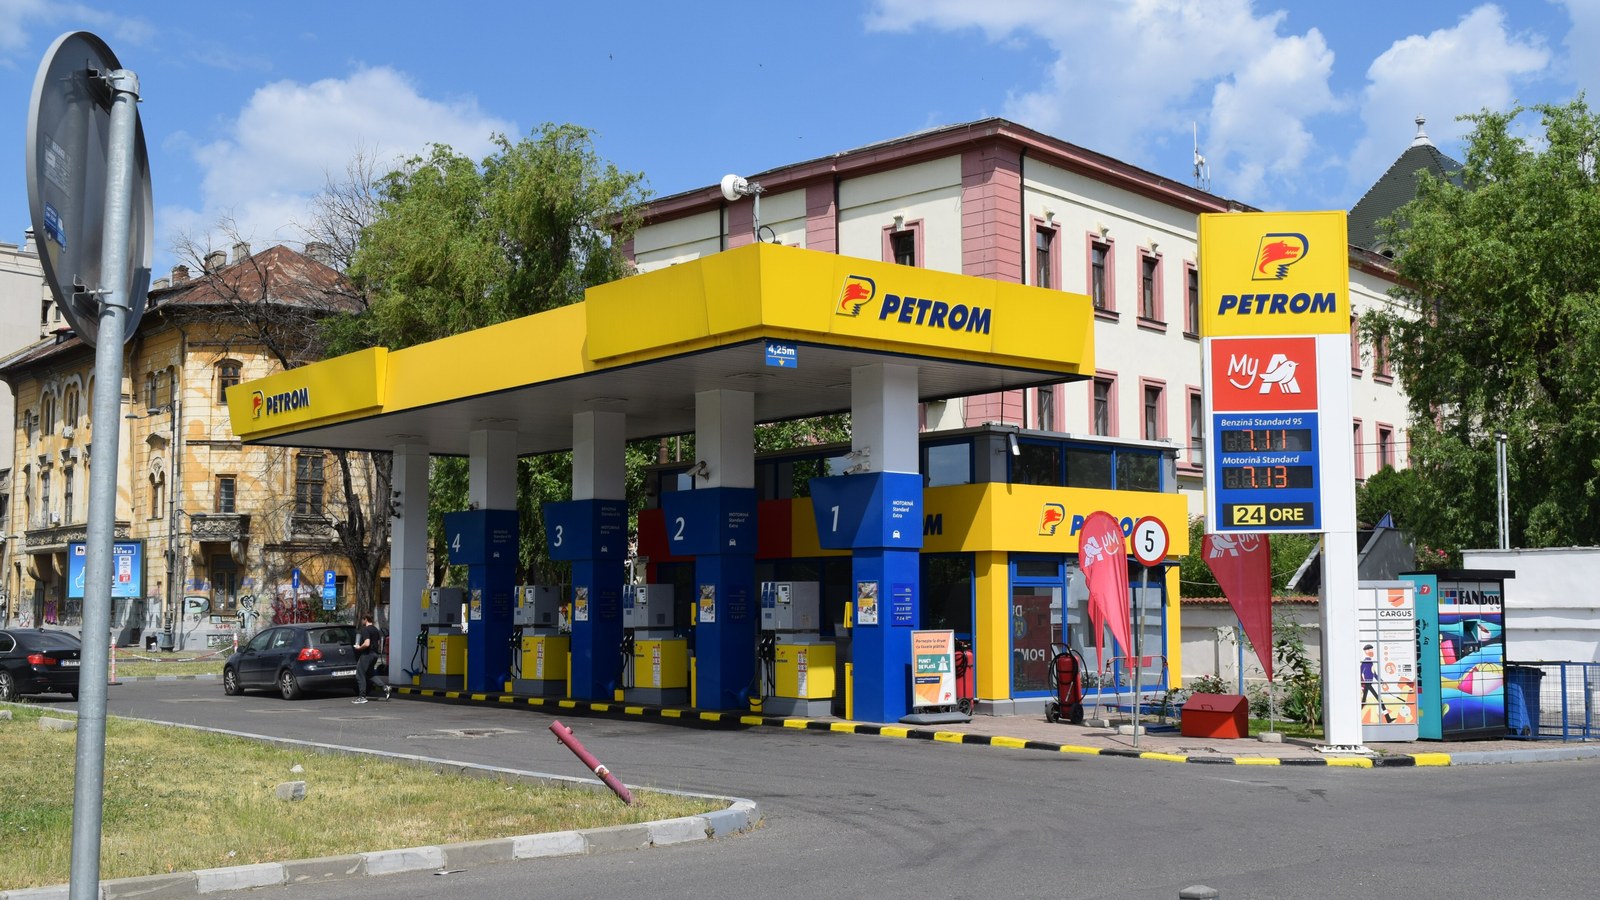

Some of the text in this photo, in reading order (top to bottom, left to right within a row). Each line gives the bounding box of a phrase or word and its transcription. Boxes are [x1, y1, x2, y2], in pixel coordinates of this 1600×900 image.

[878, 294, 992, 335] PETROM
[1217, 293, 1337, 315] PETROM
[768, 344, 795, 355] 4,25m
[1227, 354, 1259, 389] My
[266, 387, 310, 416] PETROM
[1221, 417, 1302, 427] Benzină Standard 95
[1242, 429, 1286, 451] 7.11
[1222, 455, 1299, 465] Motorină Standard
[1243, 466, 1287, 488] 7.13
[831, 505, 839, 532] 1
[1236, 507, 1304, 524] 24 ORE
[553, 525, 563, 547] 3
[674, 516, 685, 541] 2
[451, 533, 461, 553] 4
[1144, 529, 1155, 553] 5
[326, 572, 333, 583] P
